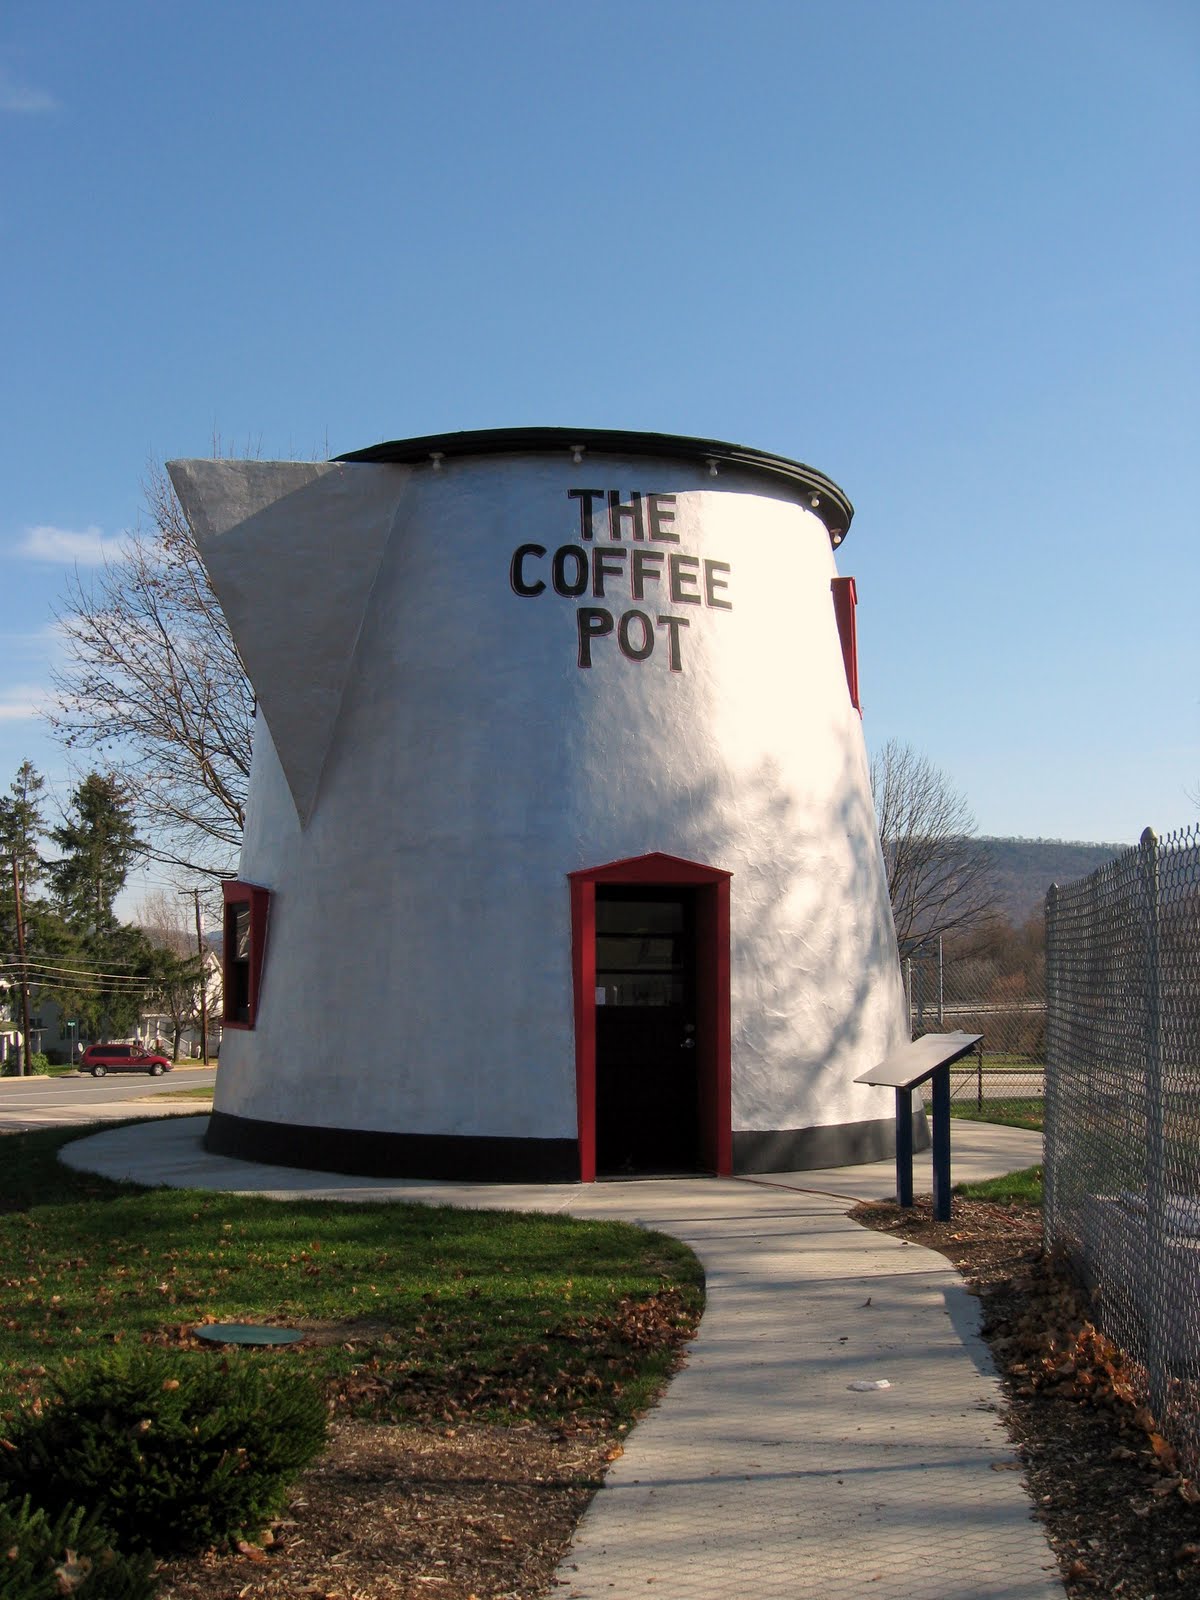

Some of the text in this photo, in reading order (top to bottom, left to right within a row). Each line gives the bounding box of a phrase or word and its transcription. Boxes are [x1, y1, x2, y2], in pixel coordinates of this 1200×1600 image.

[567, 489, 680, 543] THE
[510, 543, 733, 610] COFFEE
[577, 607, 690, 673] POT
